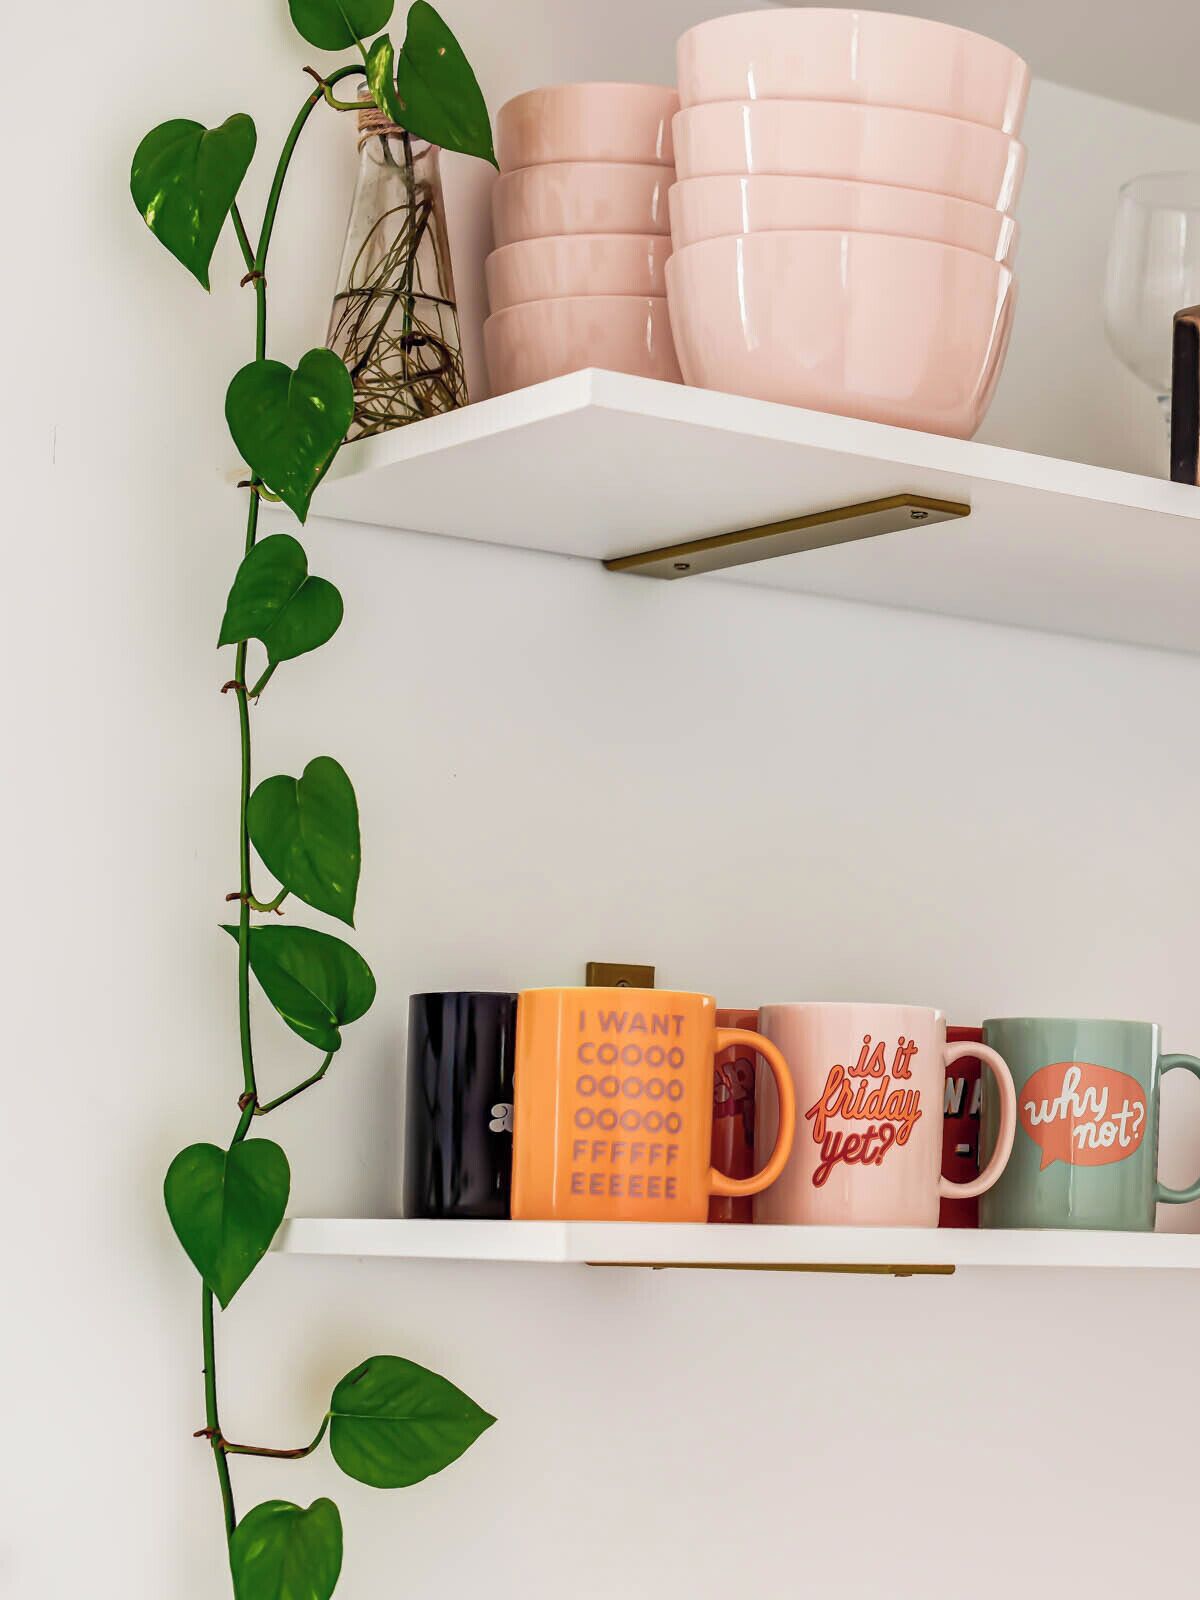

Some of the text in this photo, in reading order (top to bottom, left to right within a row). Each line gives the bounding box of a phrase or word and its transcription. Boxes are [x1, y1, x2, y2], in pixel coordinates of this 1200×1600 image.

[578, 1009, 685, 1037] I WANT
[577, 1041, 685, 1070] COOOO
[847, 1034, 919, 1080] is it
[575, 1074, 684, 1102] OOOOO
[1024, 1066, 1109, 1125] why
[804, 1064, 923, 1146] friday
[574, 1106, 683, 1135] OOOOO
[1072, 1099, 1145, 1149] not?
[572, 1138, 679, 1167] FFFFFF
[811, 1122, 897, 1188] yet?
[570, 1171, 678, 1200] EEEEEE
